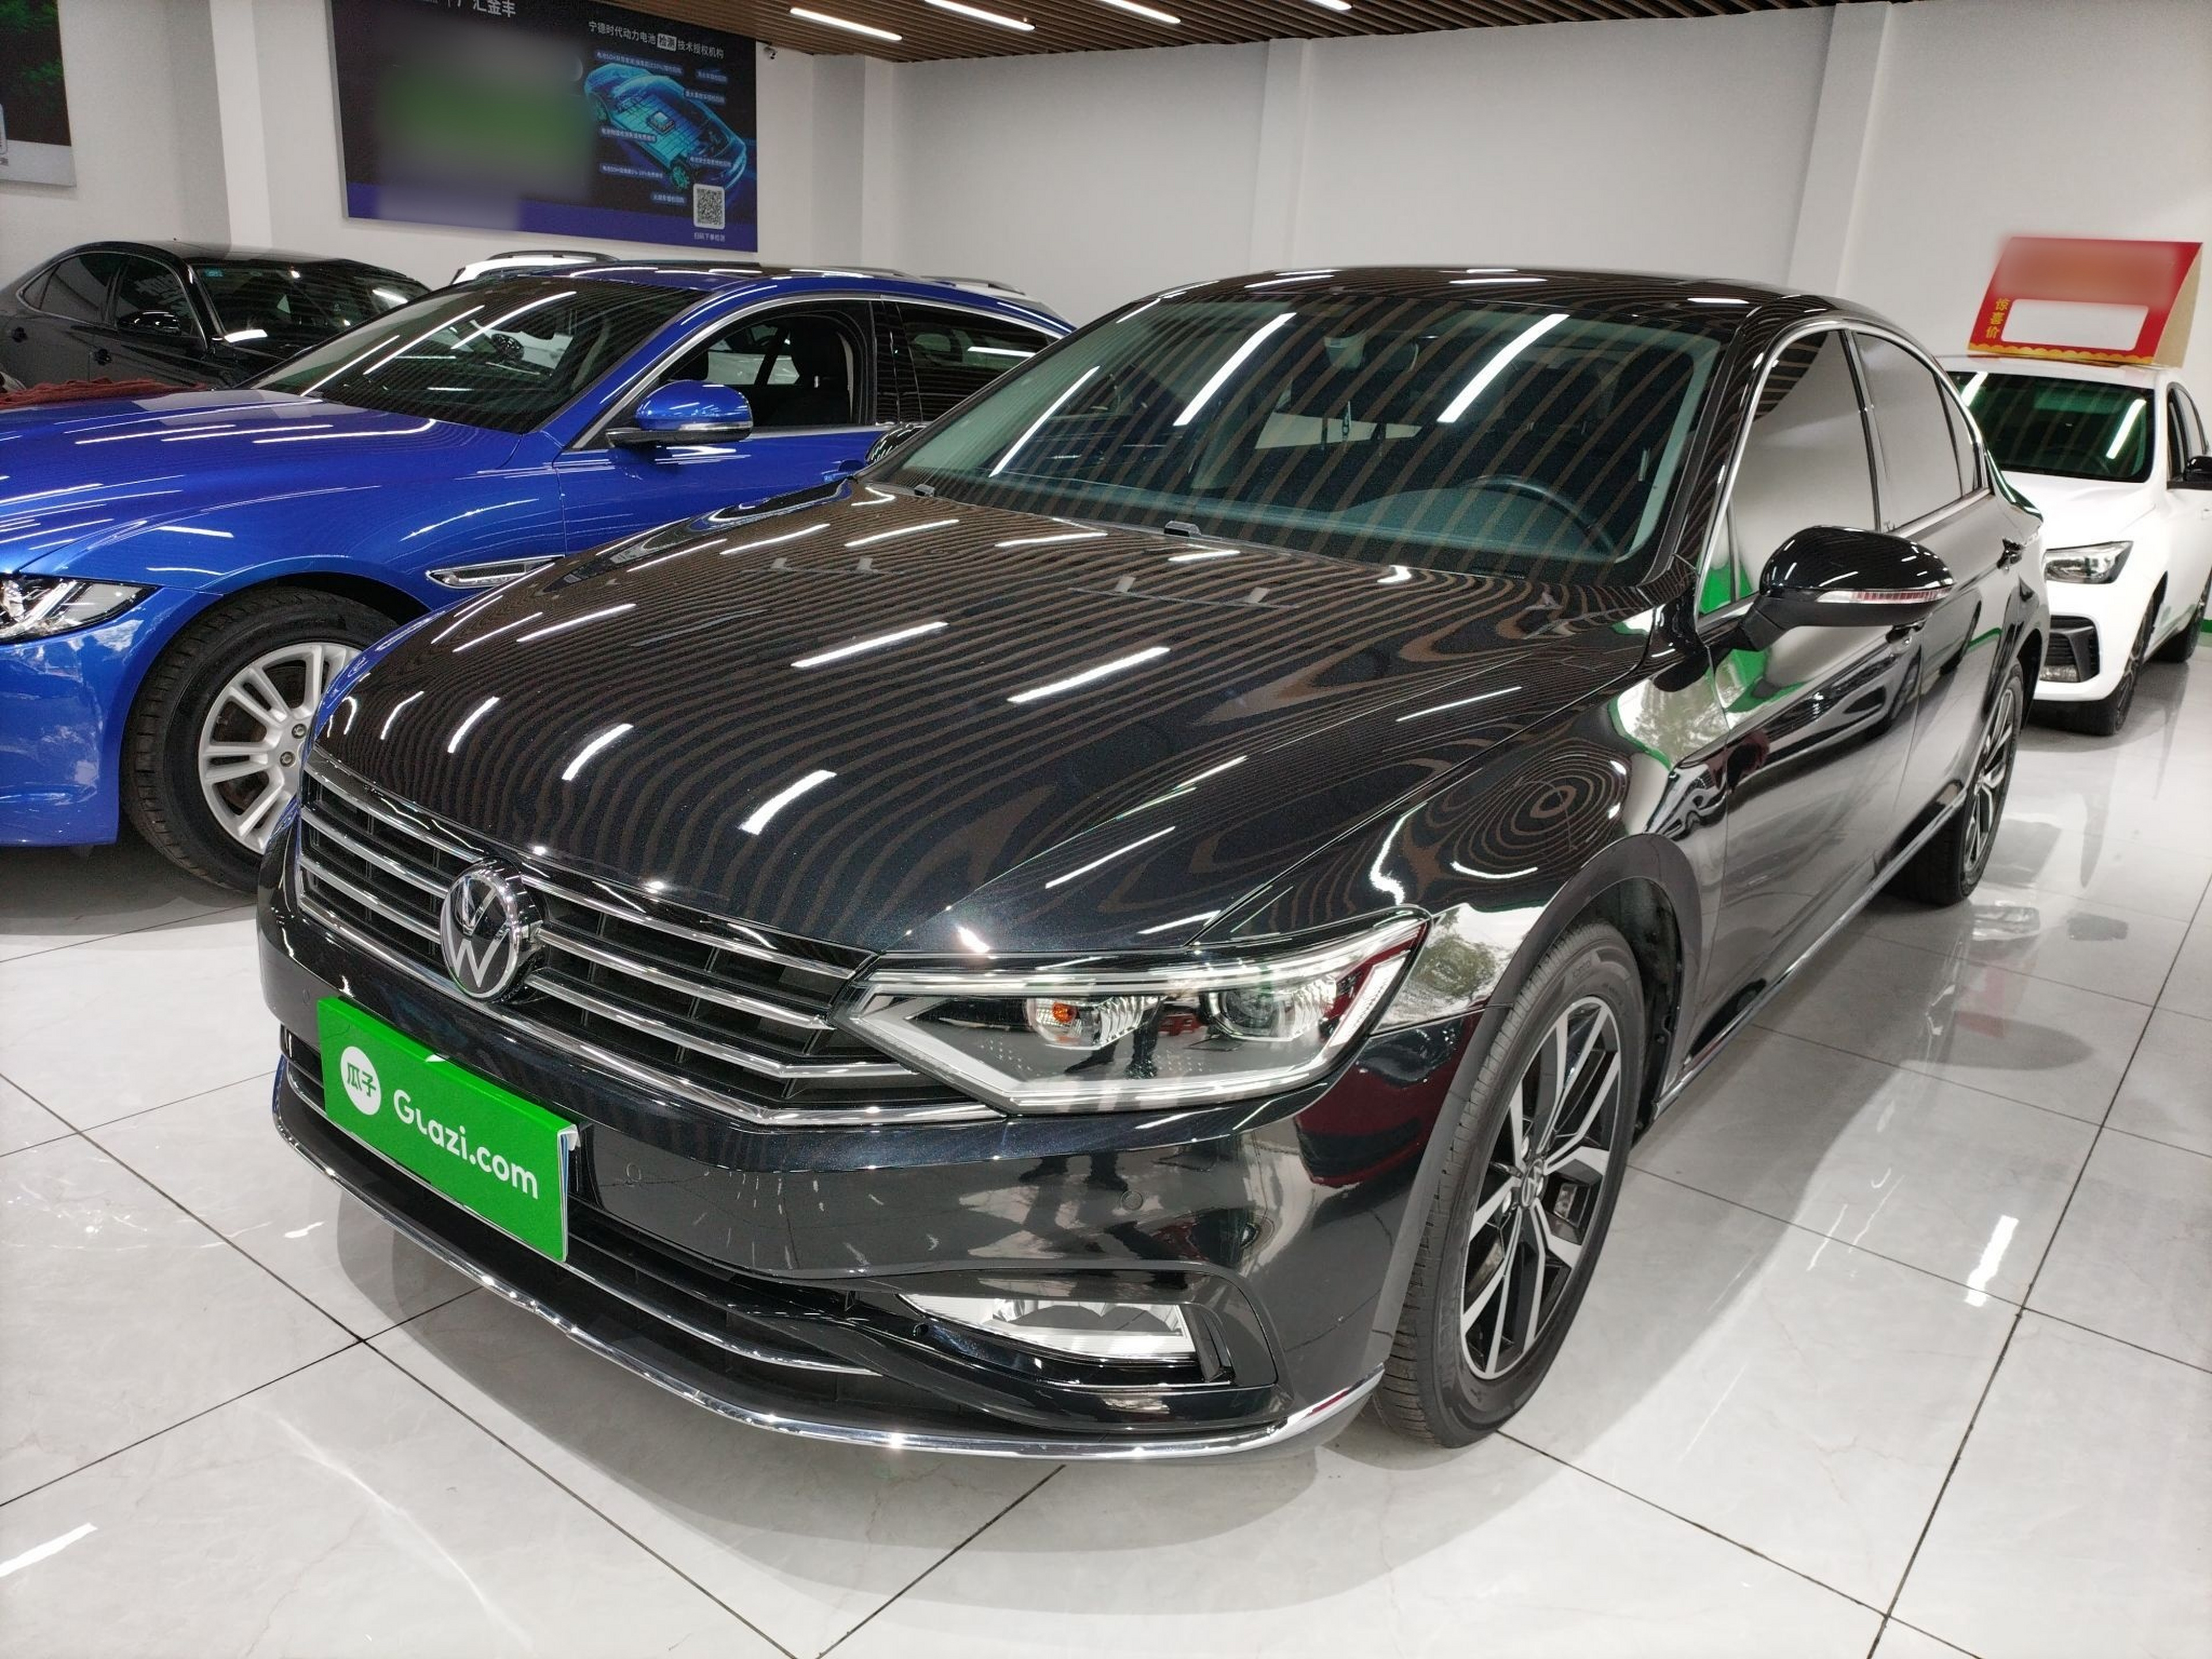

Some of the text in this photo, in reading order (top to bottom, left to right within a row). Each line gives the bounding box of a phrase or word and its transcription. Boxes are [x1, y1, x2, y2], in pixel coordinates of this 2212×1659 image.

[1986, 297, 2011, 339] 惊喜价
[347, 1062, 377, 1097] 瓜子
